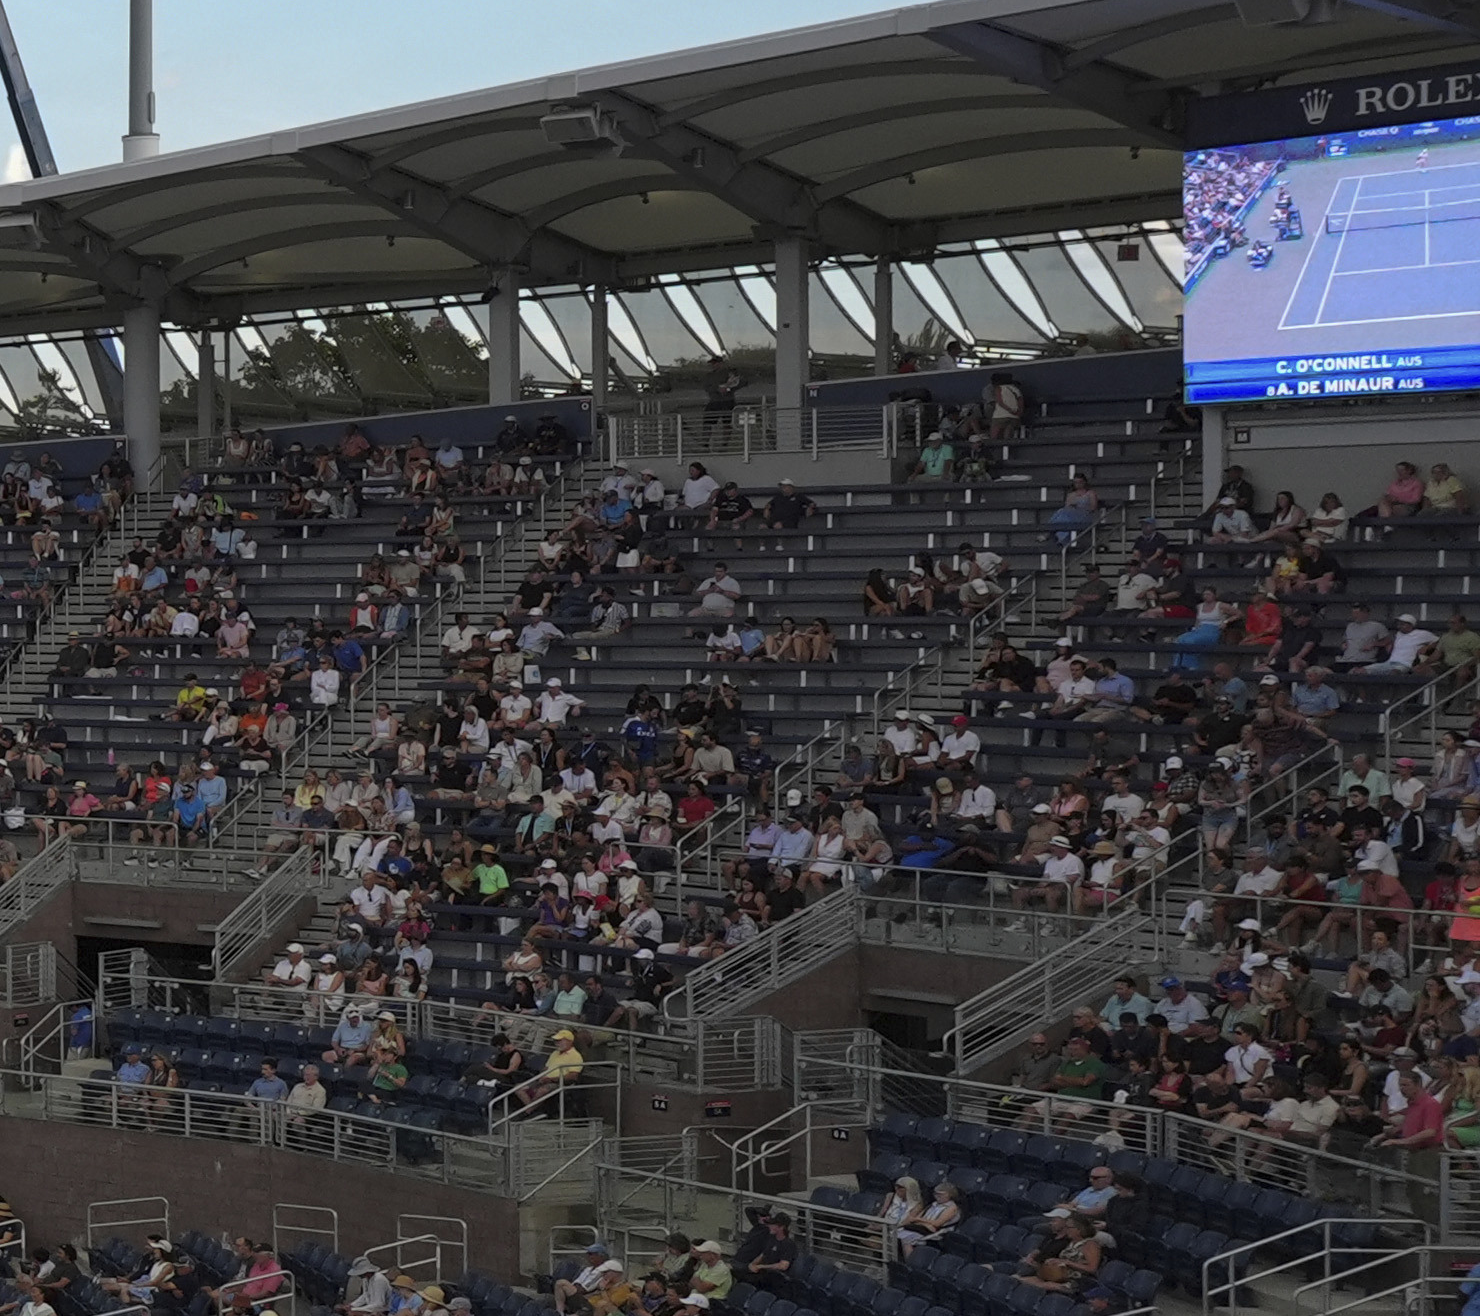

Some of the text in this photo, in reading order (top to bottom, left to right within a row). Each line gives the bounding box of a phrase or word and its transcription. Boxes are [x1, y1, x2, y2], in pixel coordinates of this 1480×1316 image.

[1354, 73, 1480, 116] ROLE
[1276, 355, 1423, 374] C. O'CONNELL AUS
[1276, 383, 1293, 395] A.
[1298, 381, 1320, 394] DE
[1324, 377, 1394, 393] MINAUR
[1397, 378, 1424, 389] AUS
